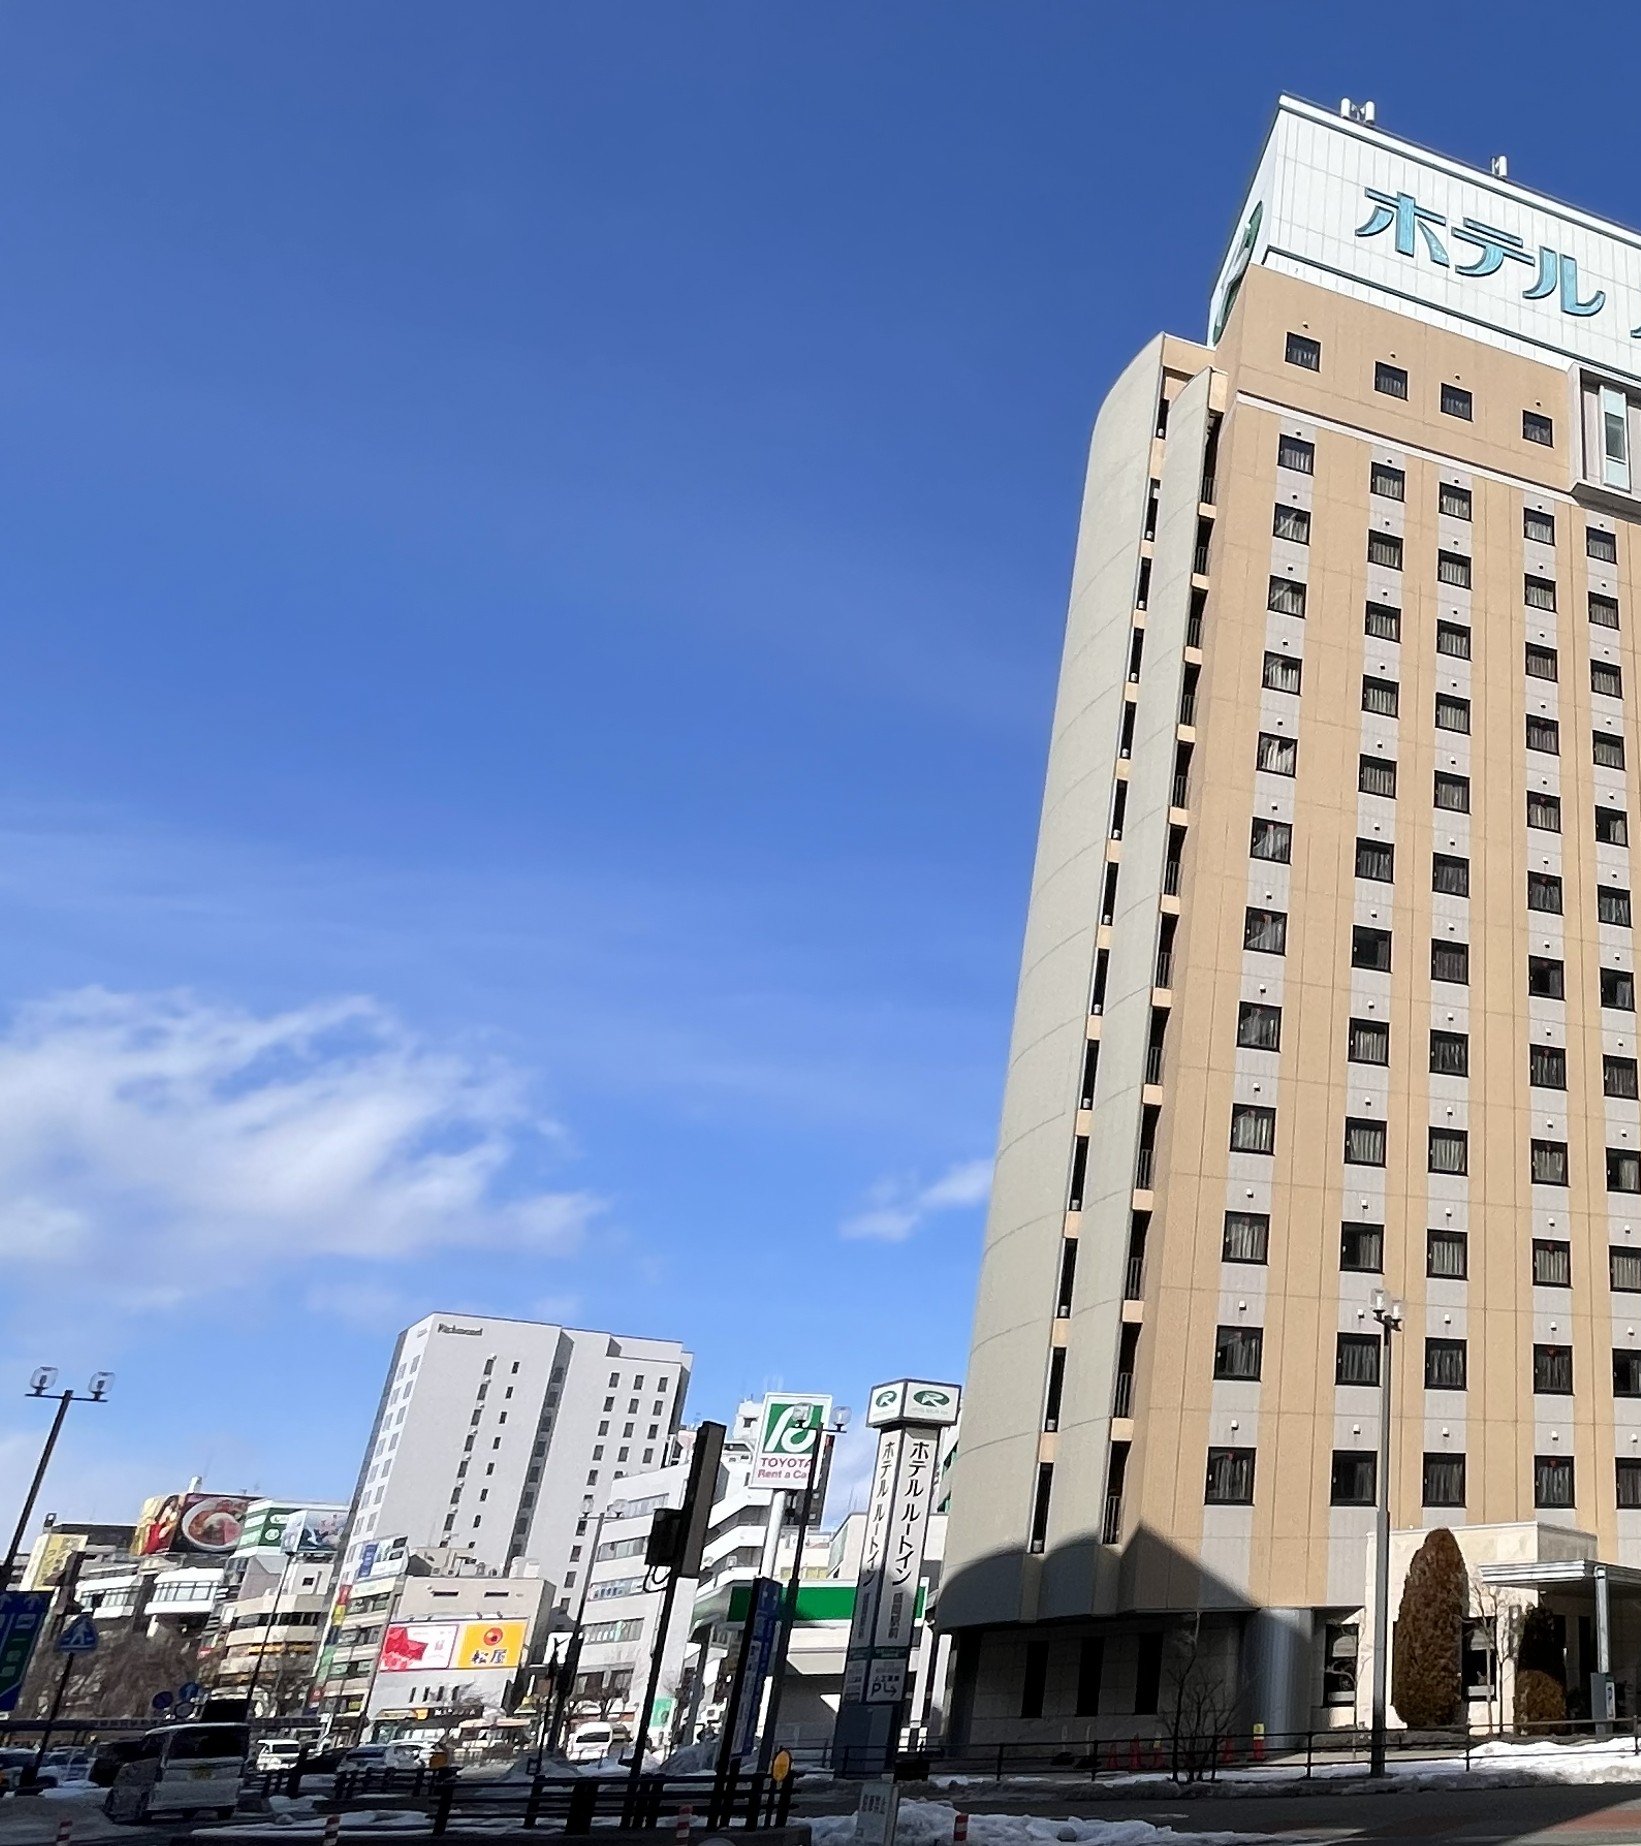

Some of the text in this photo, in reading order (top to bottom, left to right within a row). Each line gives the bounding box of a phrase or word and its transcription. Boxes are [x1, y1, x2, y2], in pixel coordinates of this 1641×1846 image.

[1355, 187, 1606, 317] ホテル
[758, 1469, 782, 1479] Rent
[784, 1471, 791, 1479] a
[760, 1457, 813, 1468] TOYOTA
[877, 1441, 896, 1499] ホテル
[904, 1441, 930, 1498] ホテル
[863, 1503, 885, 1587] ルートイン
[891, 1503, 921, 1587] ルートイン
[471, 1648, 507, 1665] 松屋
